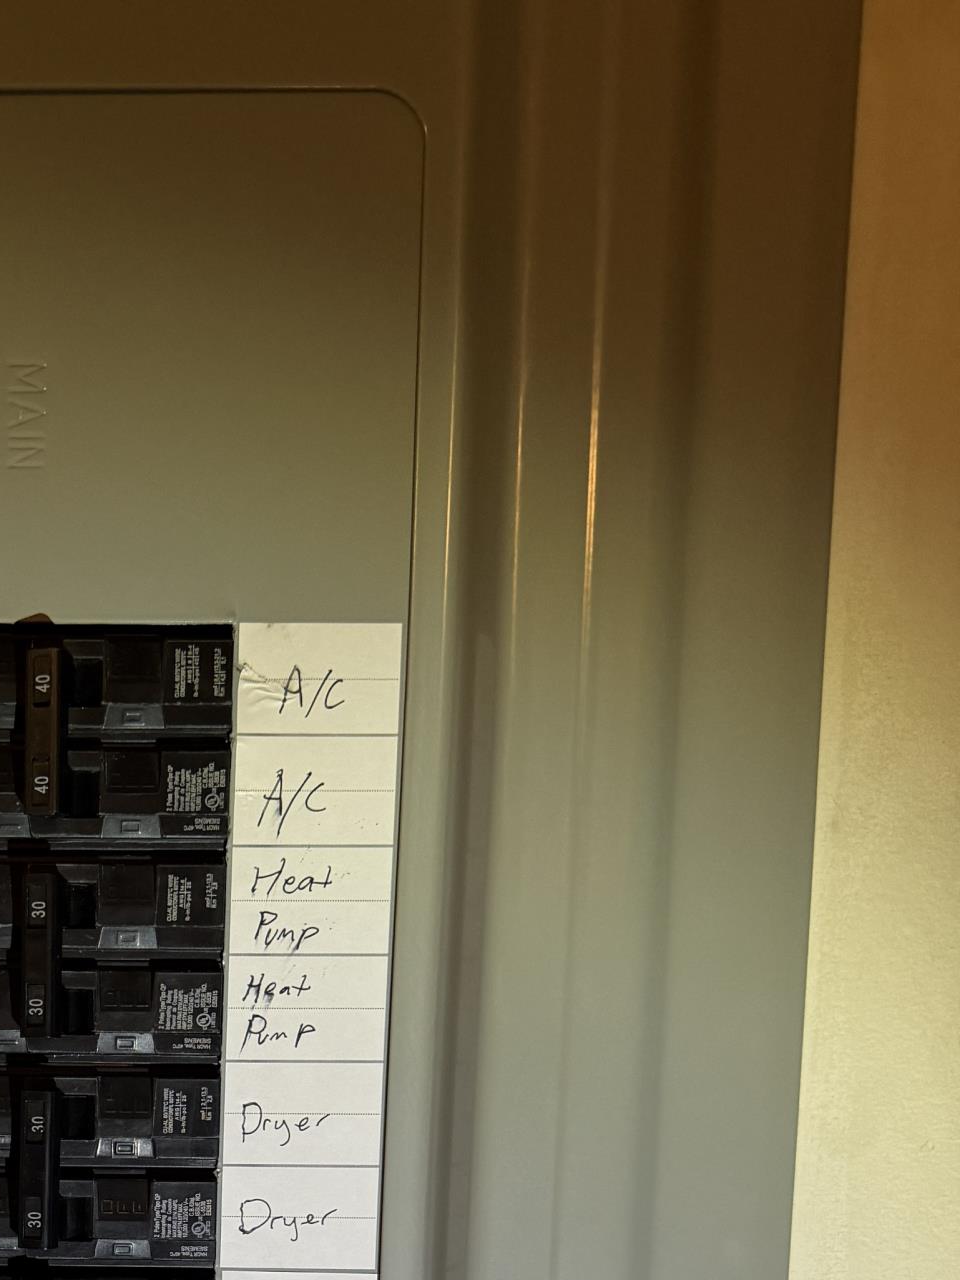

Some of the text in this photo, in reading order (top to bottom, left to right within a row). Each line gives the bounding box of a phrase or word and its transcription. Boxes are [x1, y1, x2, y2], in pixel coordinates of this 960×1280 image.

[8, 363, 48, 470] MAIN
[36, 675, 50, 693] 40
[278, 665, 345, 718] A/C
[35, 776, 49, 794] 40
[258, 769, 326, 838] A/C
[251, 858, 332, 895] Heat
[32, 901, 45, 918] 30
[255, 911, 319, 952] Pump
[29, 999, 44, 1015] 30
[243, 975, 311, 1003] Heat
[240, 1014, 316, 1053] Pump
[31, 1116, 44, 1133] 30
[242, 1102, 330, 1146] Dryer
[28, 1212, 42, 1229] 30
[240, 1199, 337, 1241] Dryer
